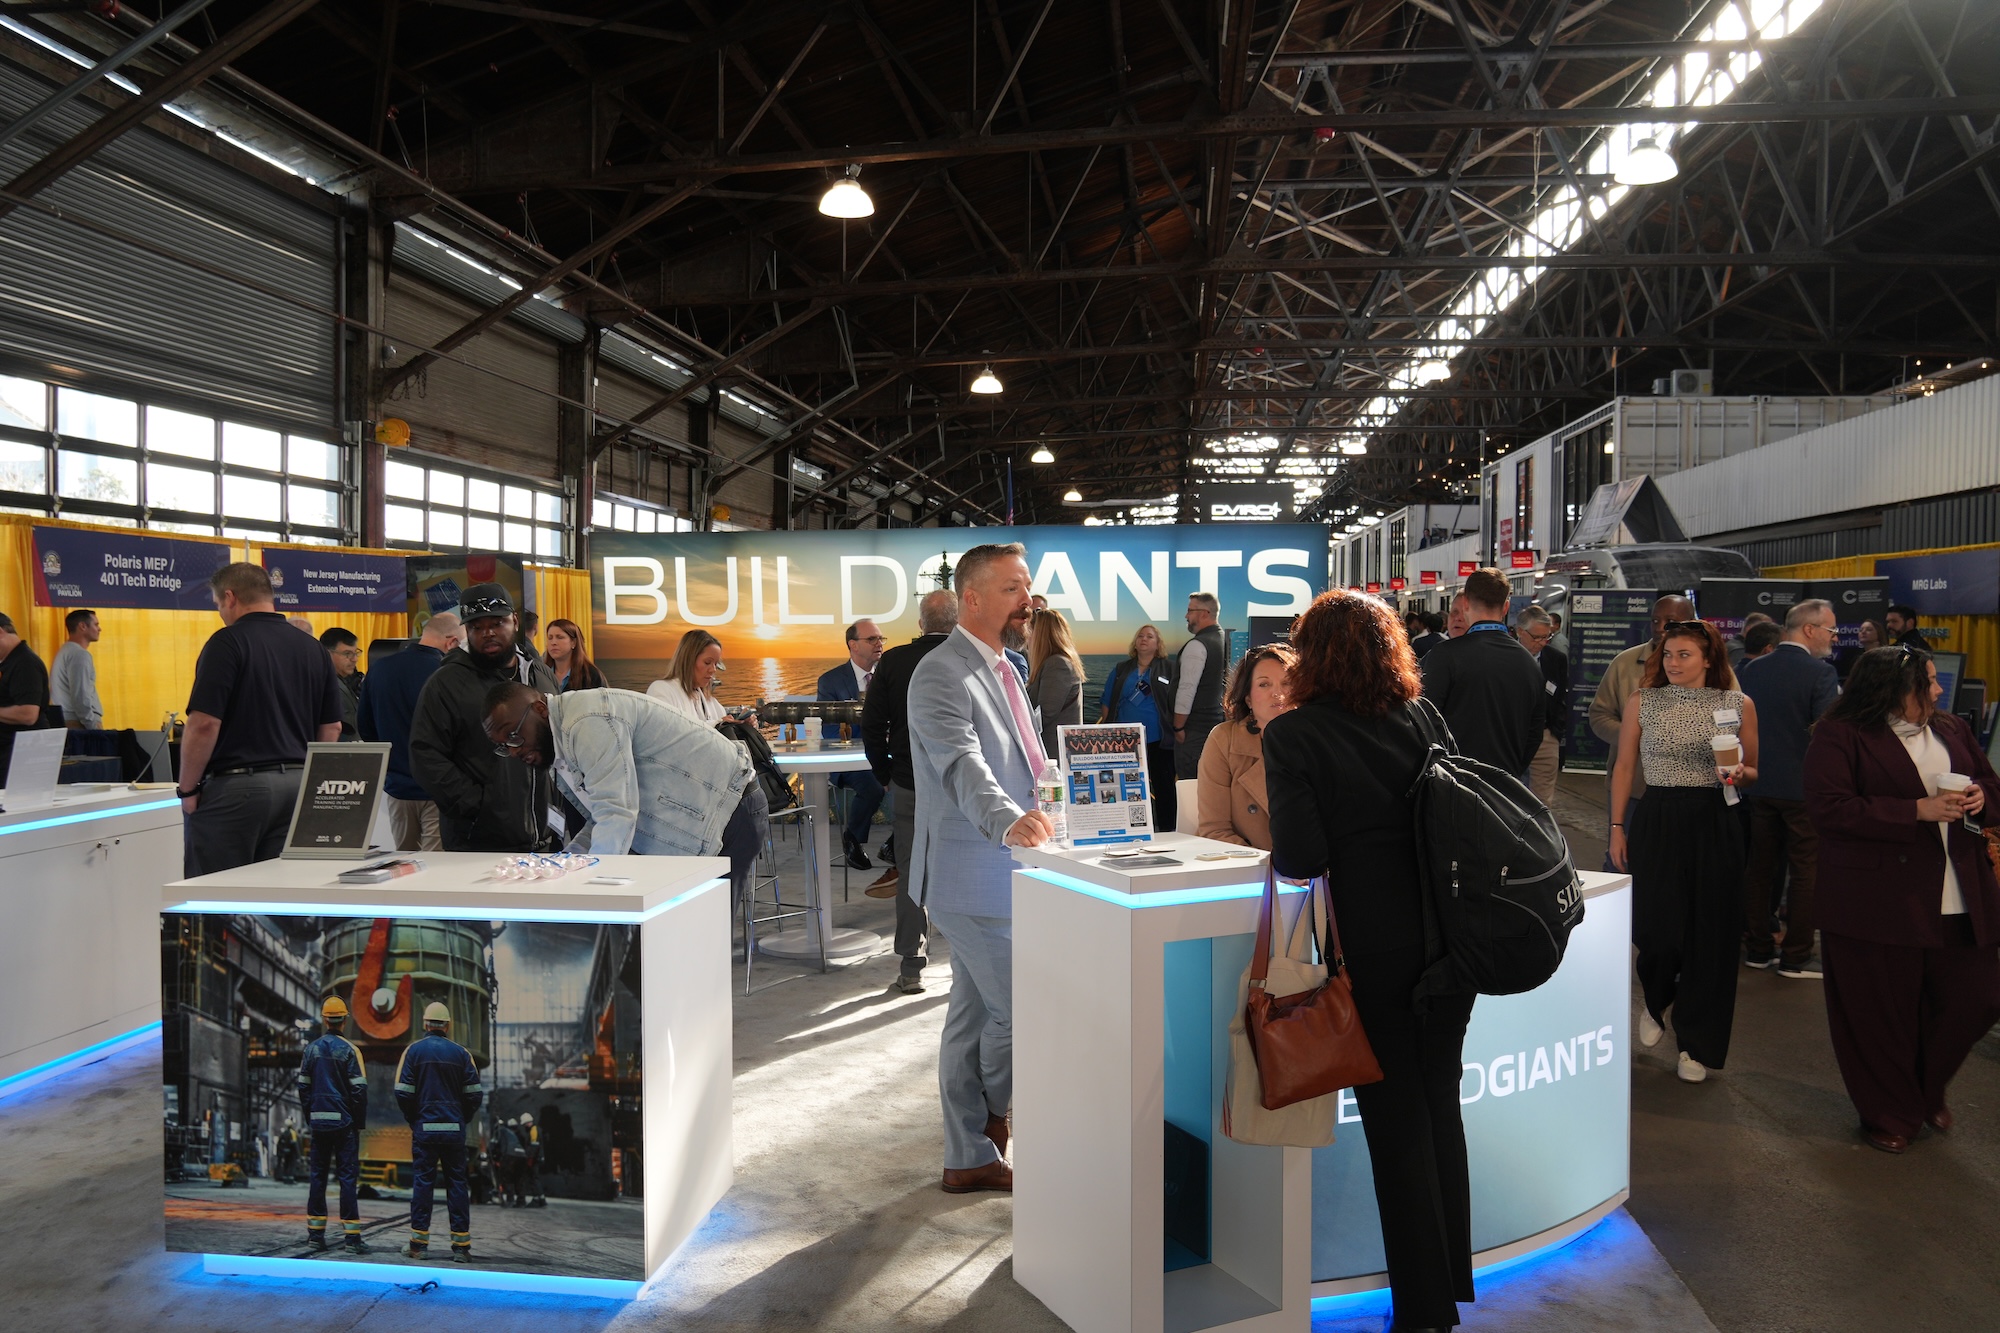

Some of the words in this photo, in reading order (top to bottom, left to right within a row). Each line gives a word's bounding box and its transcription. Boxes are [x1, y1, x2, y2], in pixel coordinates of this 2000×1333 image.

[104, 553, 142, 570] Polaris
[144, 556, 168, 571] MEP
[169, 559, 175, 572] /
[100, 572, 119, 586] 401
[121, 573, 147, 588] Tech
[148, 574, 182, 591] Bridge
[303, 569, 318, 579] New
[318, 570, 338, 581] Jersey
[339, 570, 381, 583] Manufacturing
[49, 583, 80, 591] INNOVATION
[603, 548, 1314, 626] BUILDANTS
[1912, 579, 1929, 590] MRG
[1930, 577, 1947, 589] Labs
[57, 589, 83, 597] PAVILION
[308, 584, 338, 594] Extension
[339, 585, 366, 596] Program,
[366, 585, 377, 595] Inc.
[1573, 602, 1602, 610] MRG
[1627, 597, 1647, 606] Analysis
[1627, 605, 1648, 613] Solutions
[1708, 620, 1725, 628] et's
[1727, 620, 1745, 628] Buil
[1920, 628, 1949, 638] REASE
[316, 780, 366, 795] ATDM
